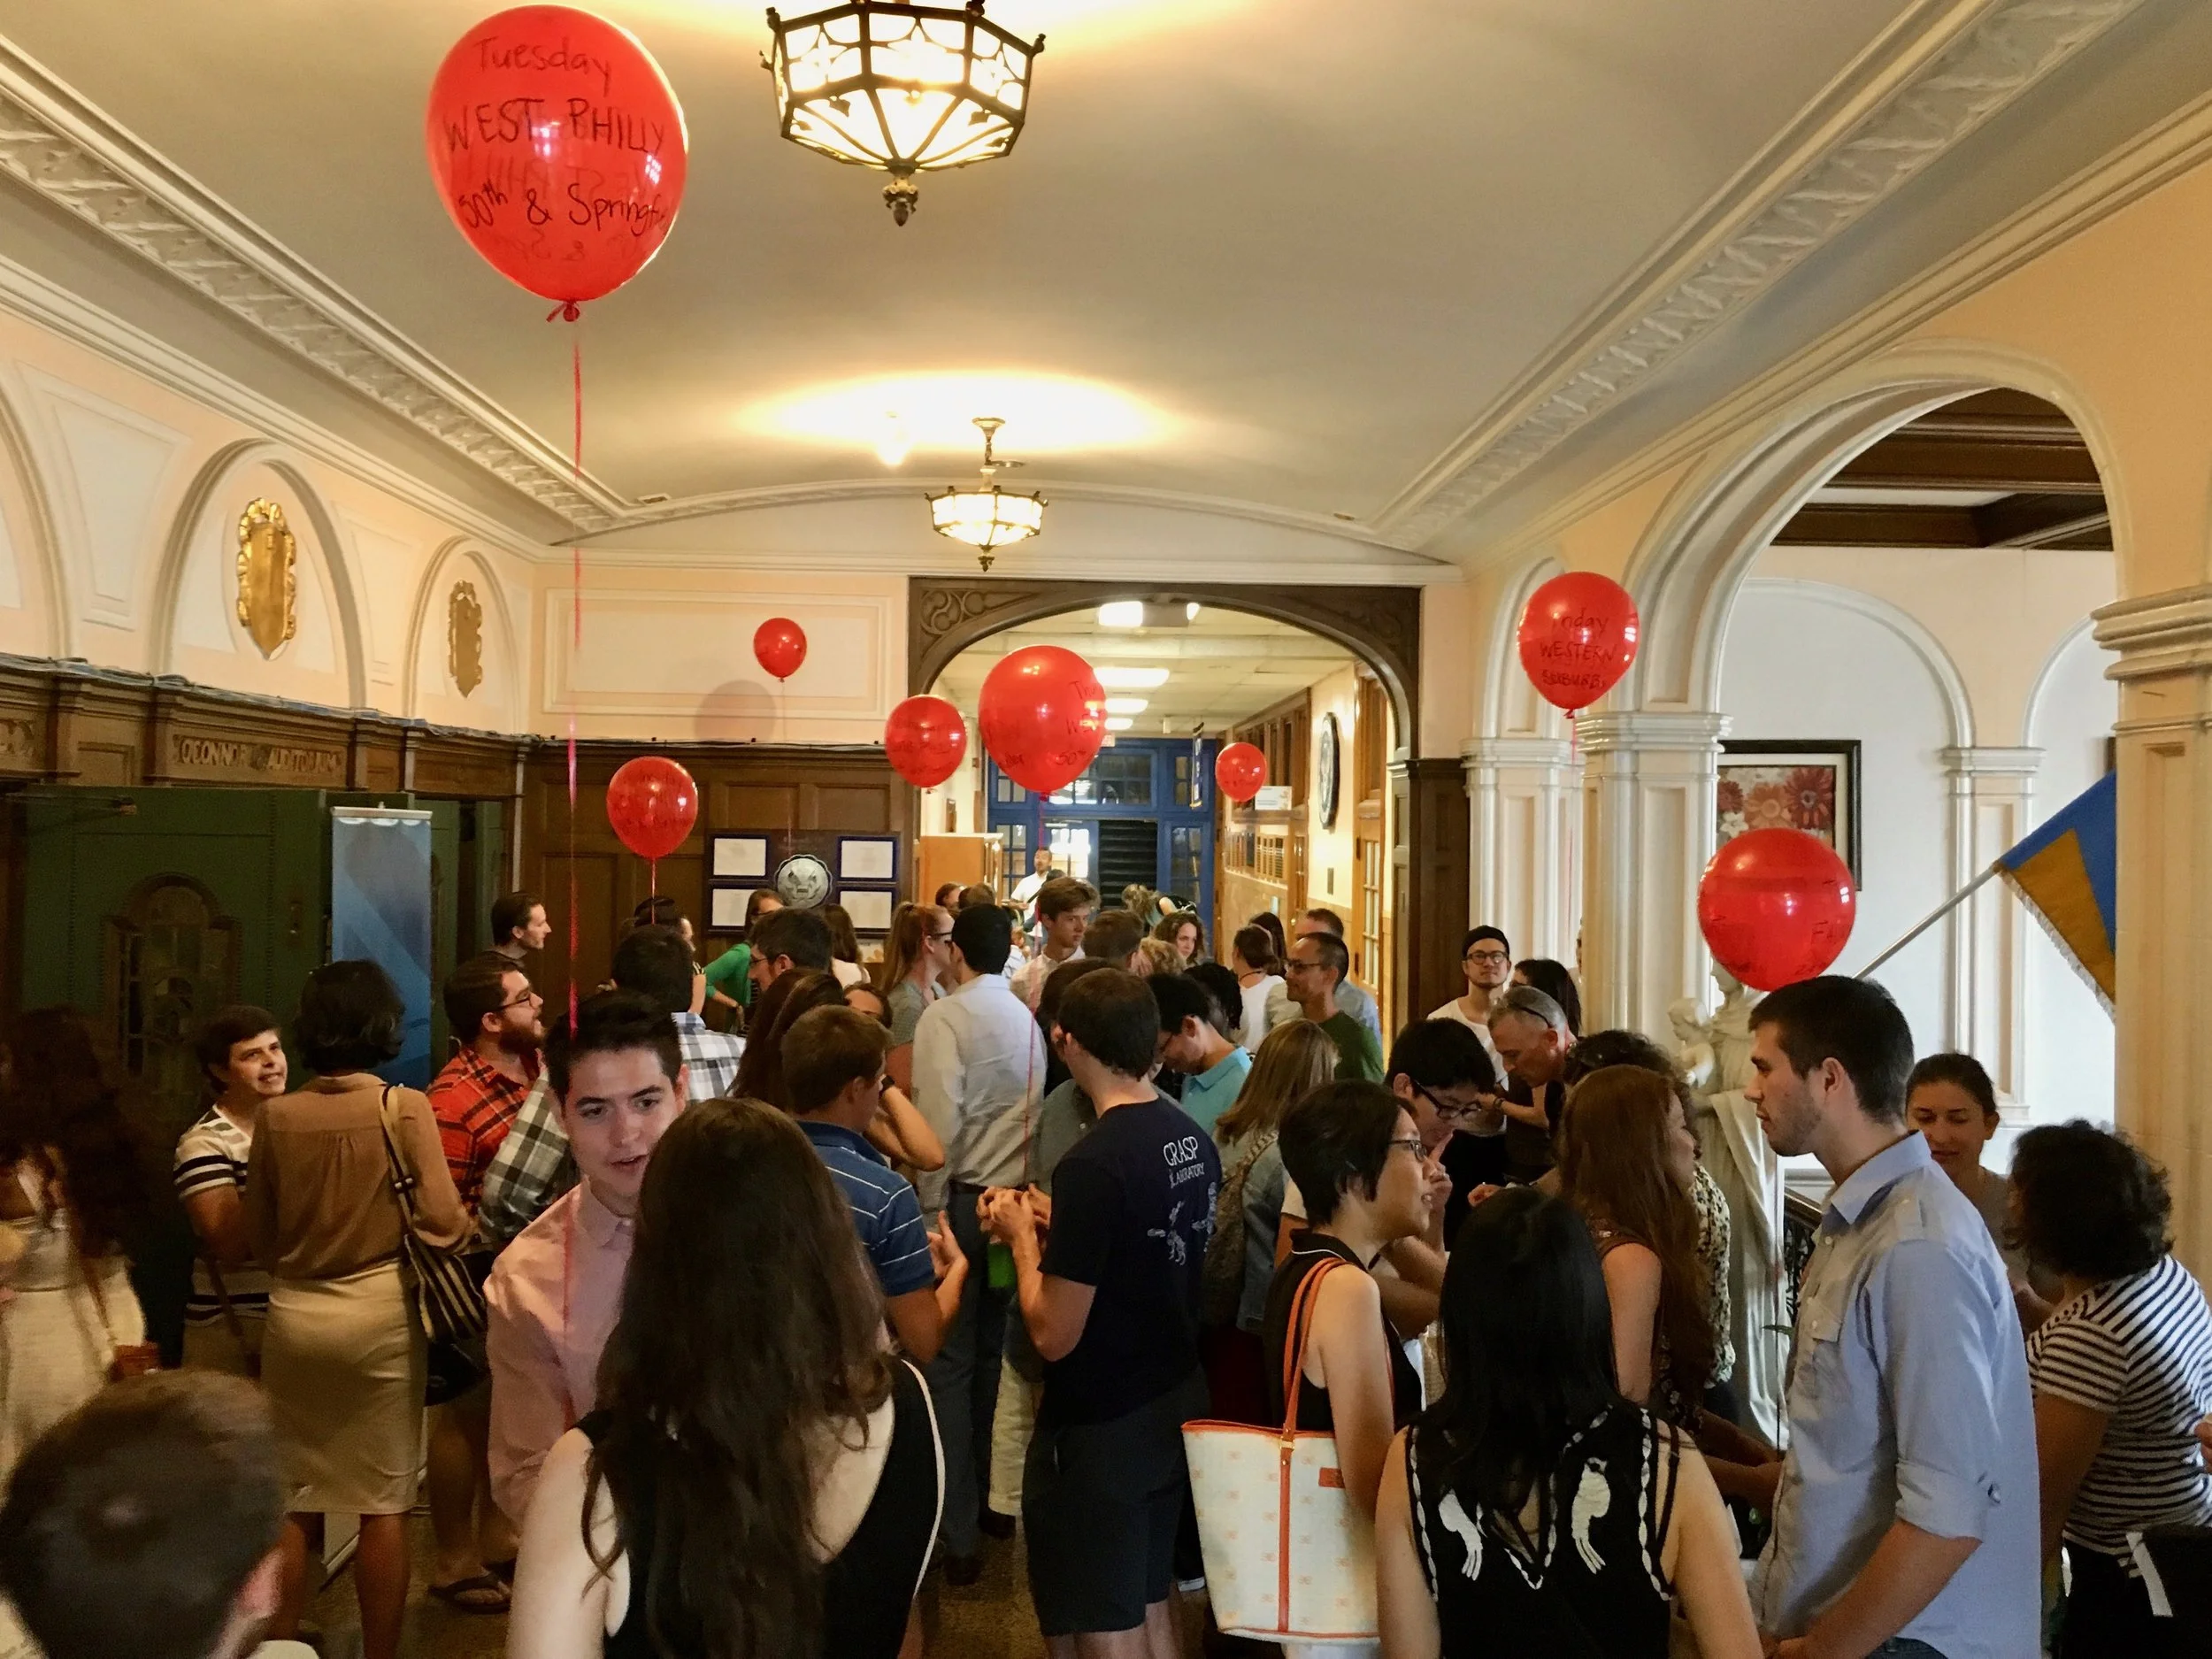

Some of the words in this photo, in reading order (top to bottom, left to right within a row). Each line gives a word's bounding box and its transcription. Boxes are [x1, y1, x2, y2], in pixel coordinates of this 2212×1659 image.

[472, 36, 613, 97] Tuesday
[442, 97, 546, 153] WEST
[567, 97, 664, 154] PHILLY
[526, 188, 552, 227] &
[1540, 641, 1617, 664] WESTERN
[1163, 1135, 1198, 1166] GRASP
